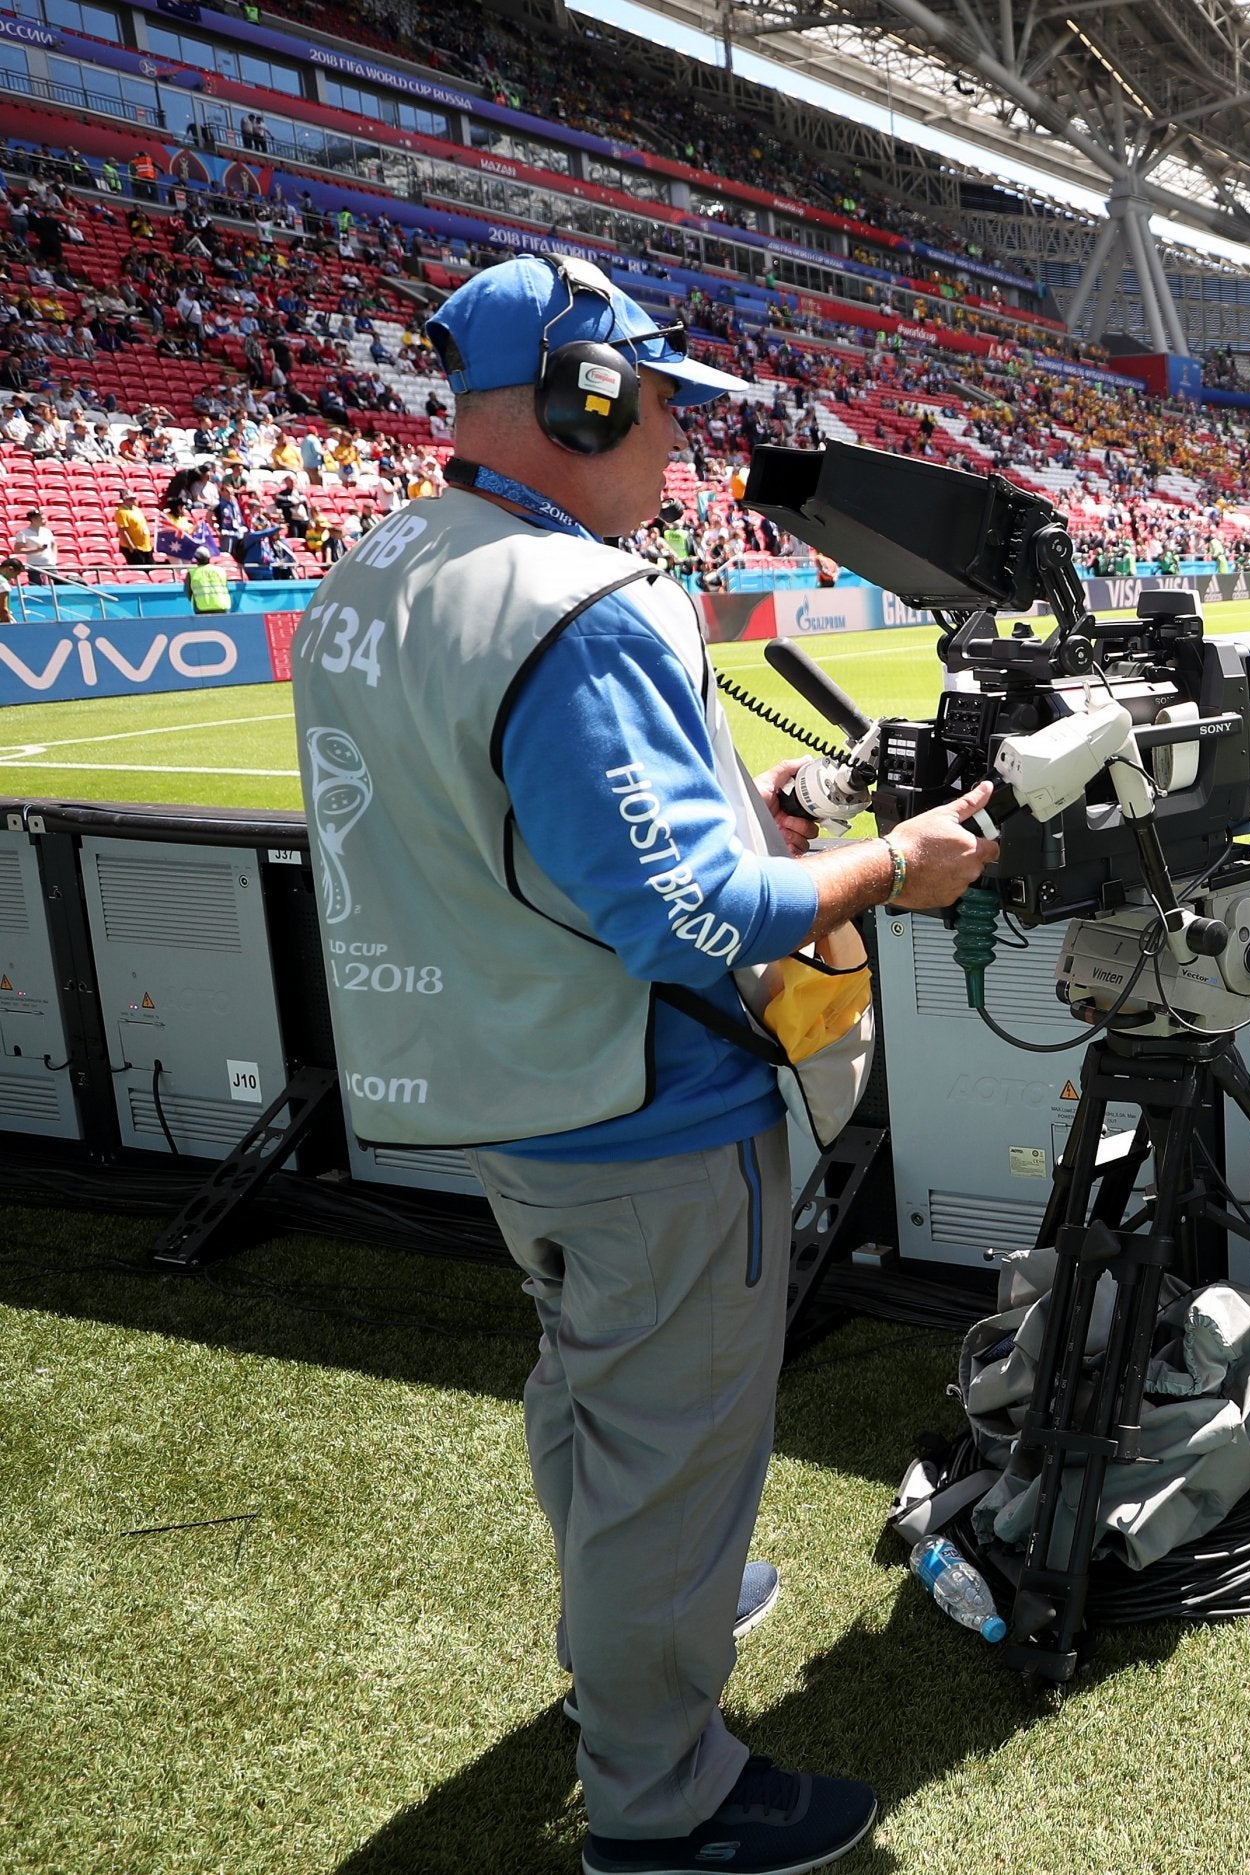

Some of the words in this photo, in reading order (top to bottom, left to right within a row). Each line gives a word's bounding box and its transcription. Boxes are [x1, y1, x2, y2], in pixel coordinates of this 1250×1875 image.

[310, 48, 338, 66] 2018
[340, 57, 364, 75] FIFA
[366, 67, 408, 88] WORLD
[408, 82, 432, 96] CUP
[433, 88, 473, 110] RUSSIA
[480, 158, 516, 177] KAZAN
[488, 226, 521, 247] 2018
[522, 235, 550, 253] FIFA
[539, 501, 573, 526] 2018
[355, 514, 428, 569] HB
[811, 615, 846, 630] GAZPROM
[1200, 722, 1232, 736] SONY
[606, 762, 682, 864] HOST
[350, 942, 388, 956] CUP
[344, 962, 444, 994] 2018
[1092, 966, 1124, 986] Vinten
[1182, 968, 1208, 982] Vector
[232, 1072, 256, 1089] J10
